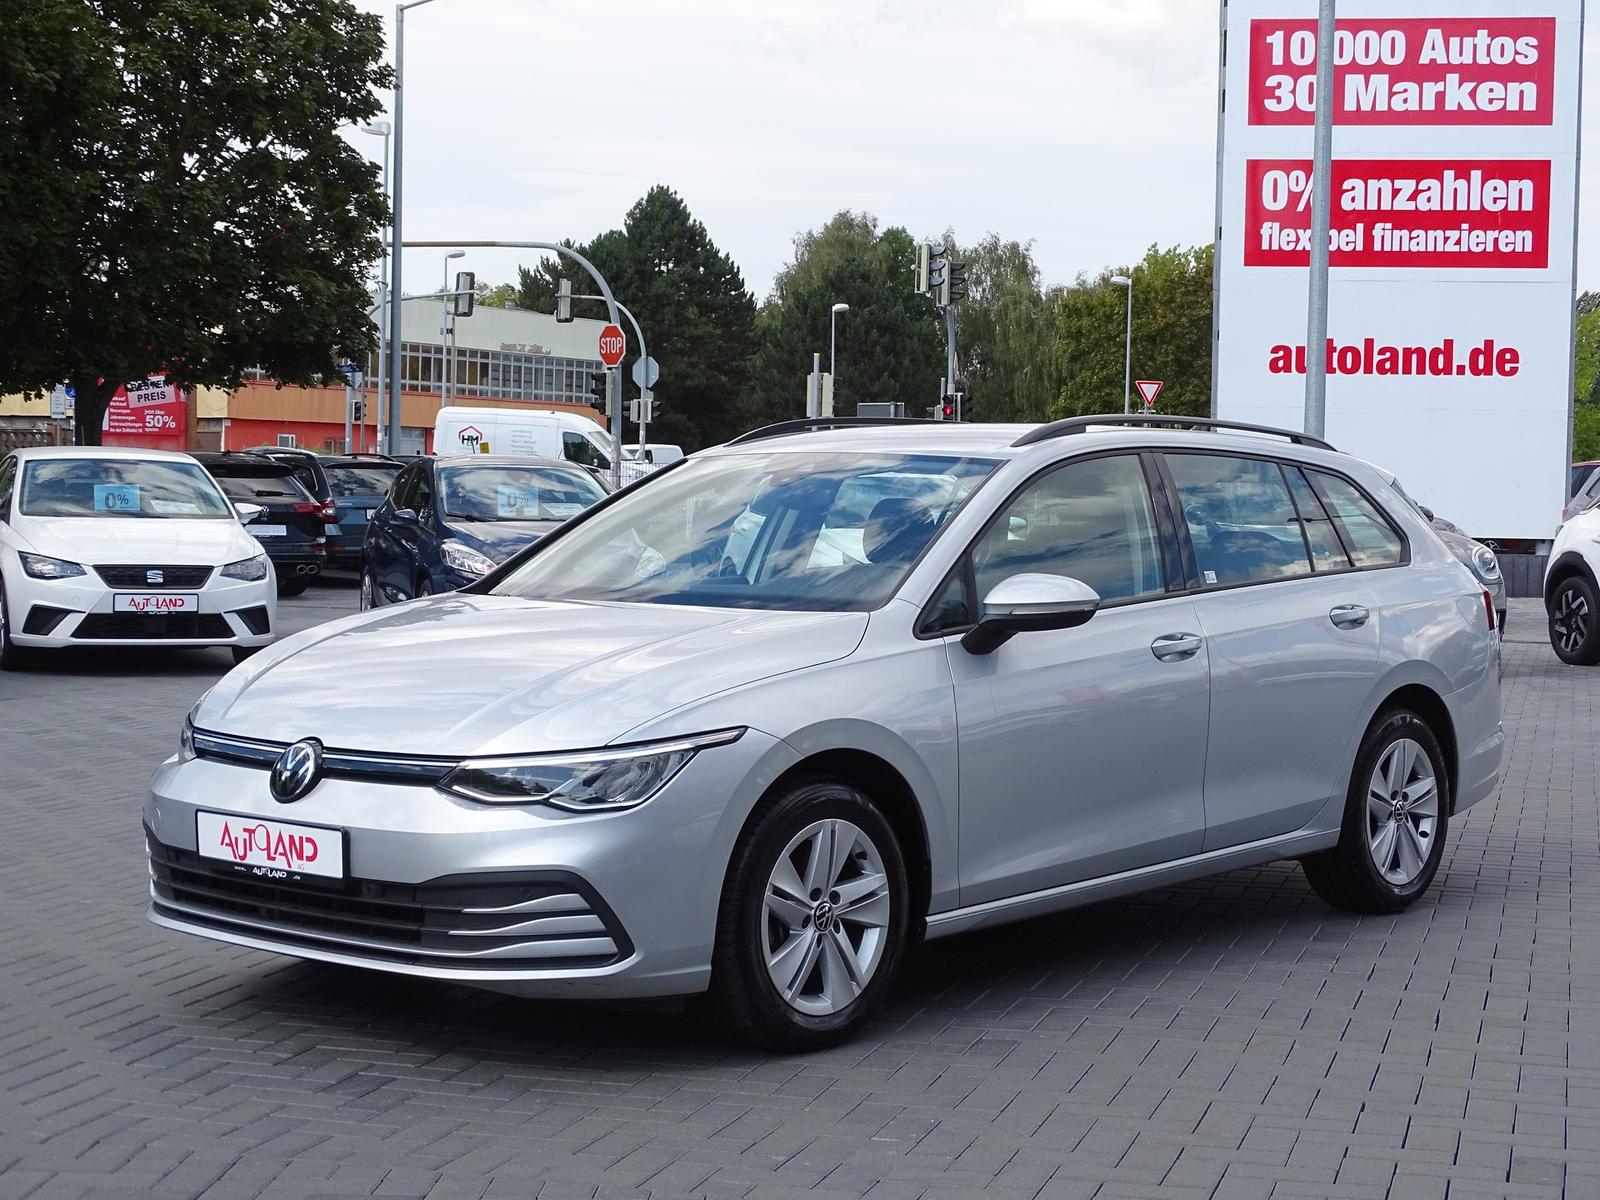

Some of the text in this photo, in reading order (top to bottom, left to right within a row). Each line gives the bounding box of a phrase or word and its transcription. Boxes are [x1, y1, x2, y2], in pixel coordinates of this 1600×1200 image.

[1266, 28, 1539, 66] 10000 Autos
[1264, 74, 1537, 112] 30 Marken
[1340, 169, 1533, 212] anzahlen
[1260, 221, 1533, 253] flexel finanzieren
[600, 337, 623, 354] STOP
[1268, 337, 1520, 377] autoland.de
[137, 391, 166, 403] PREIS
[145, 415, 176, 428] 50%
[105, 492, 129, 509] 0%
[507, 492, 529, 507] 0%
[128, 596, 185, 611] AUTOLAND
[220, 820, 319, 869] AUTOLAND
[252, 866, 287, 879] AUTOLAND
